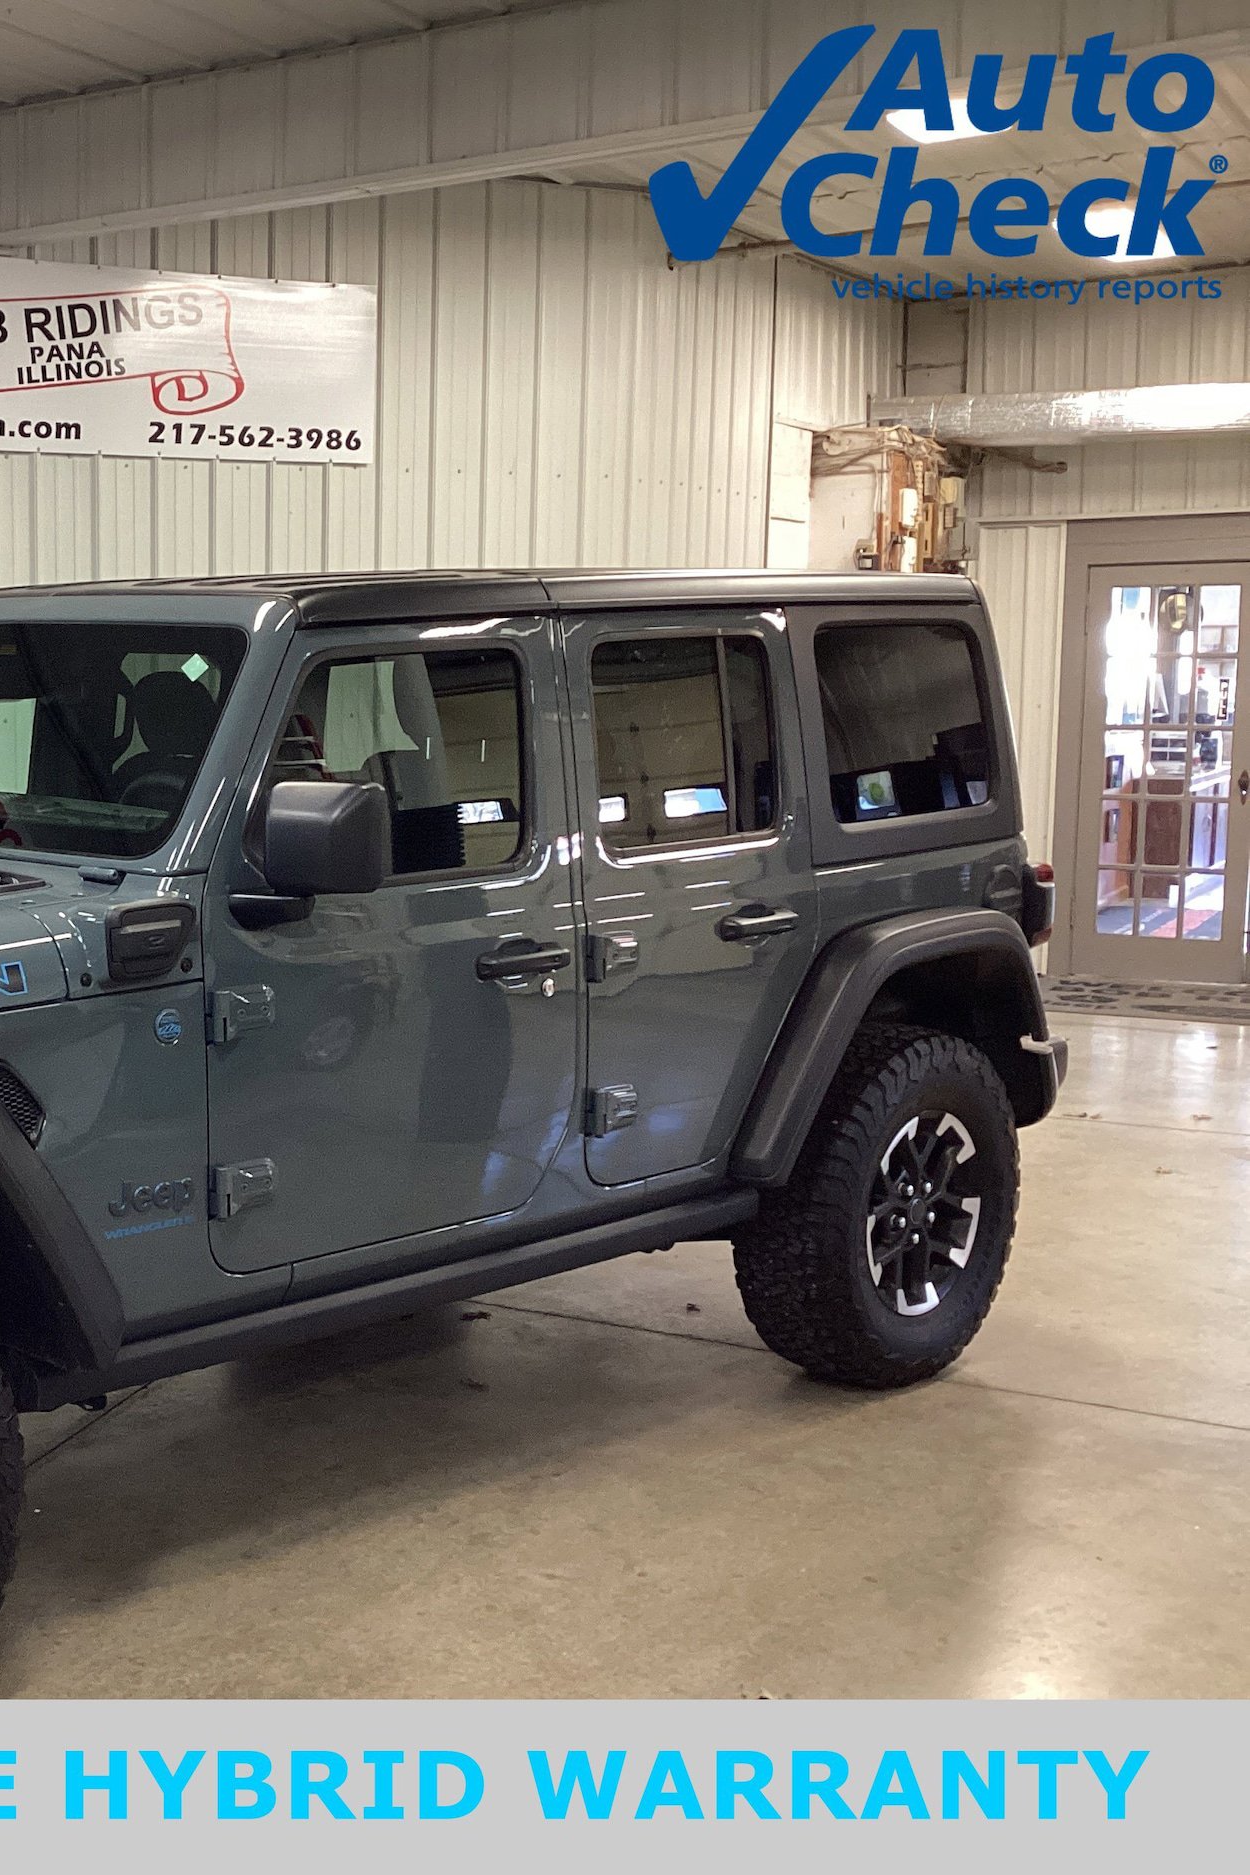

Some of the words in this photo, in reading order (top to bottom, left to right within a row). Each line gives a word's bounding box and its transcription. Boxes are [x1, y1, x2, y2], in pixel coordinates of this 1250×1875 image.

[23, 290, 203, 344] RIDINGS
[29, 341, 106, 365] PANA
[17, 357, 127, 385] ILLINOIS
[148, 421, 362, 452] 217-562-3986
[108, 1177, 193, 1217] Jeep
